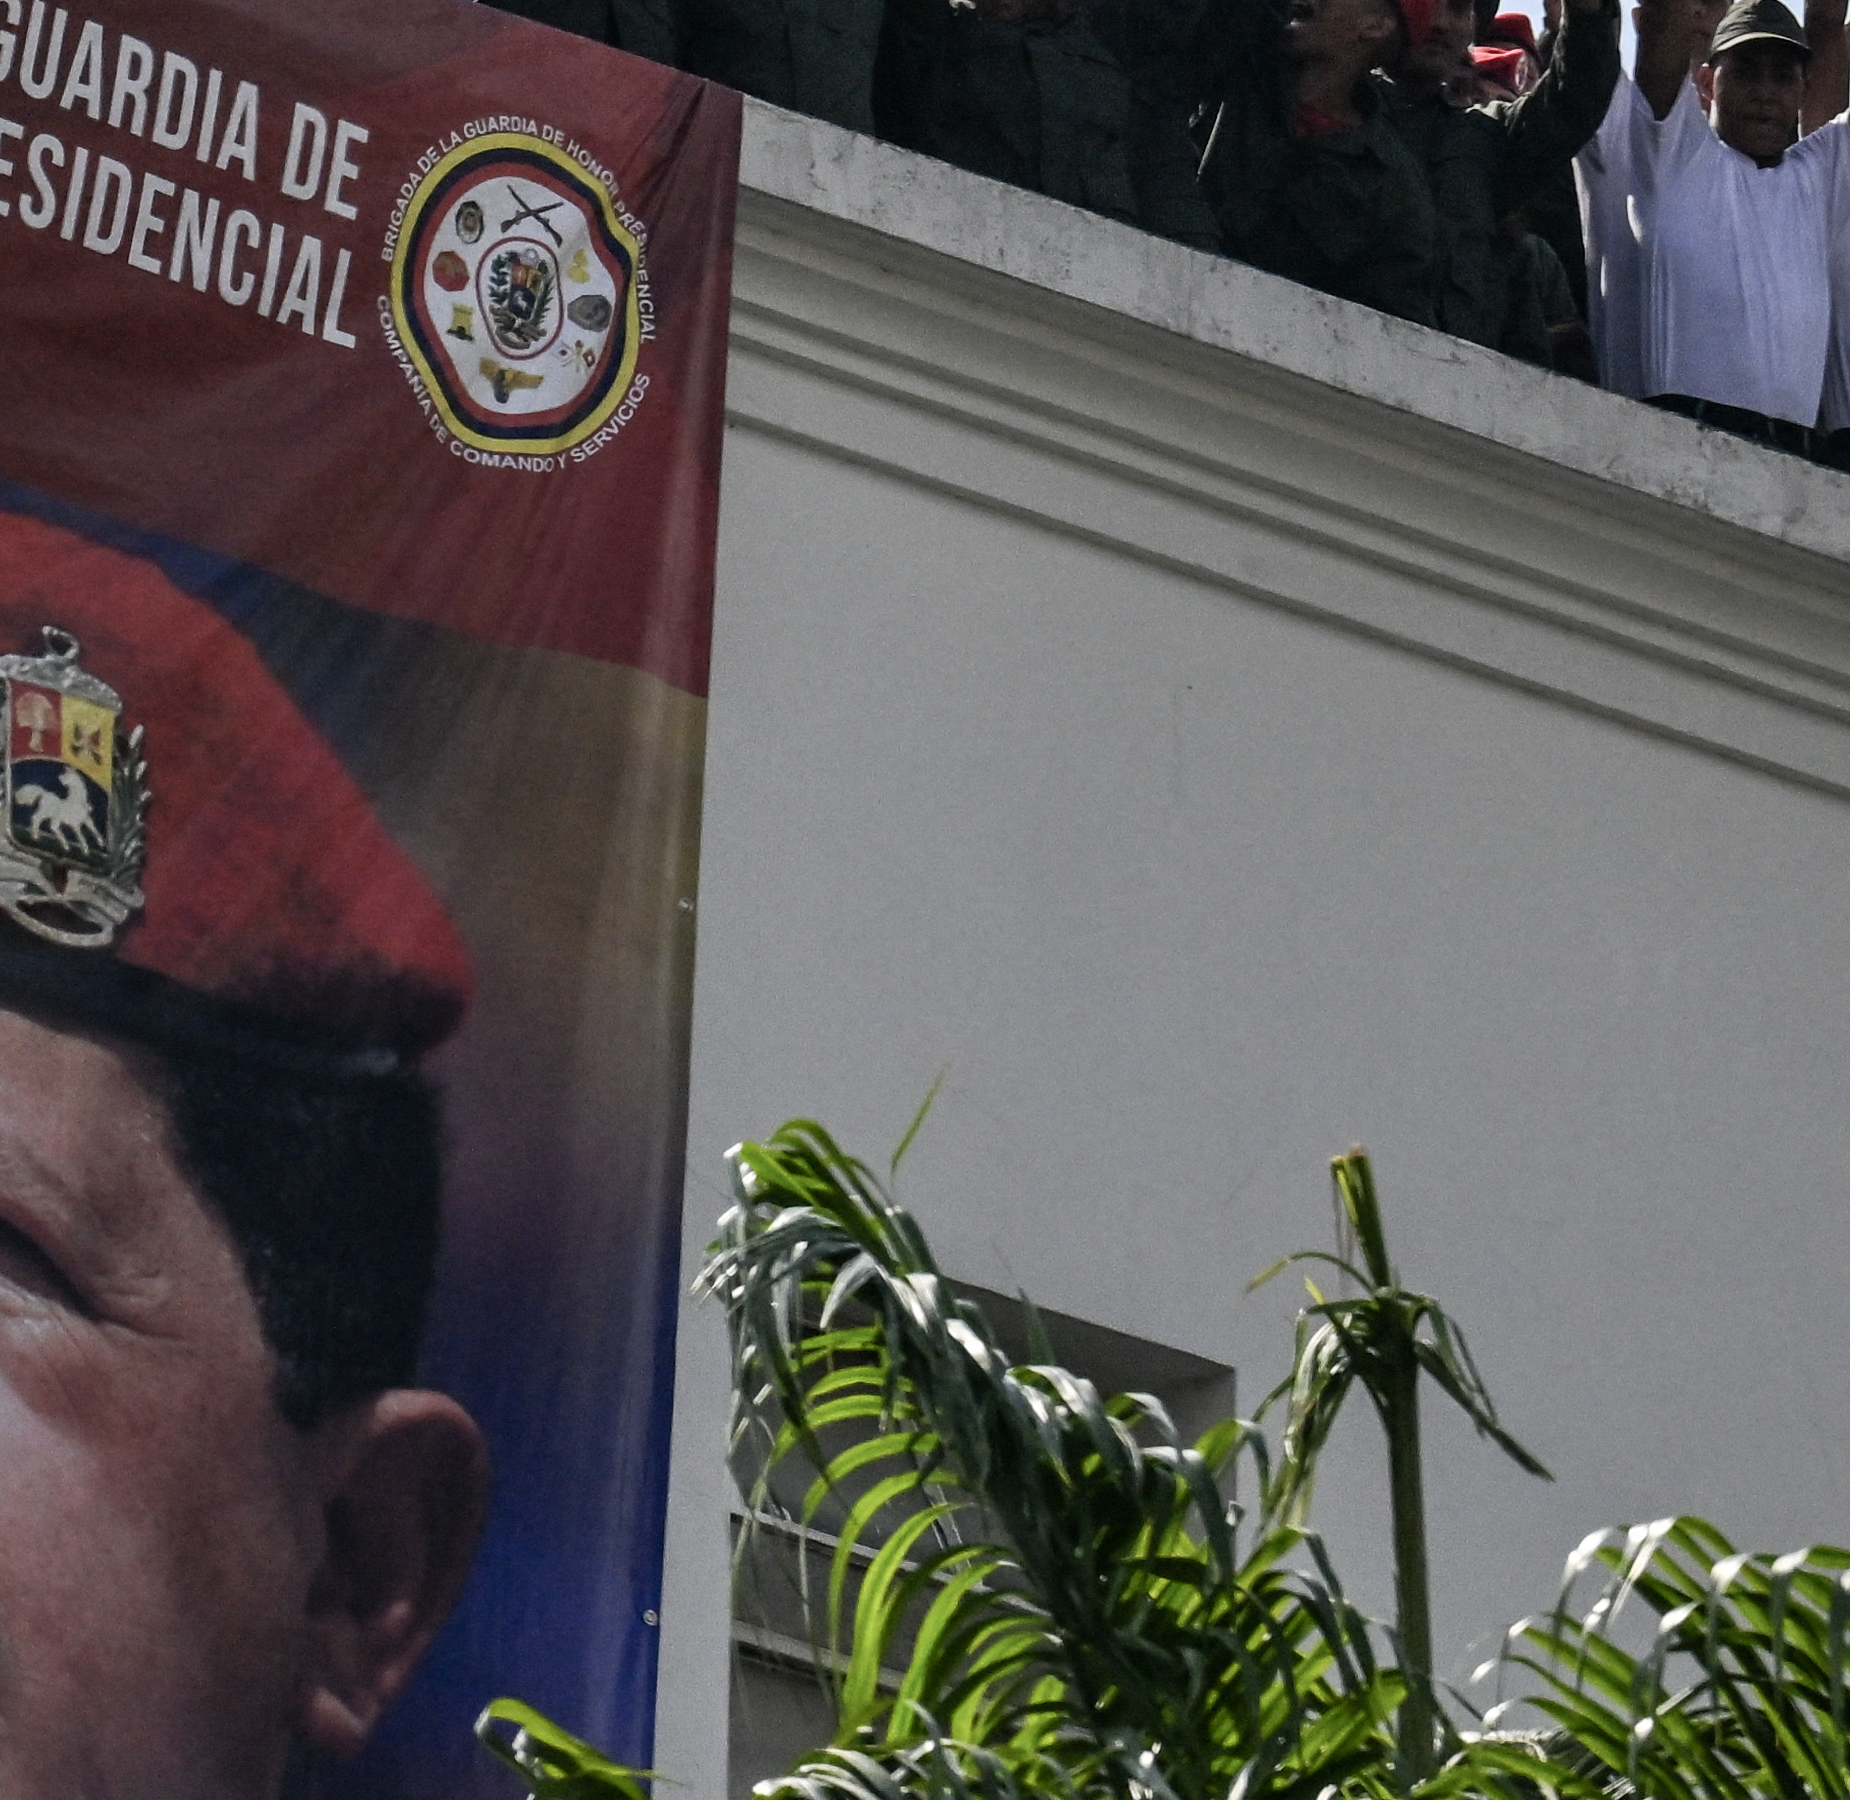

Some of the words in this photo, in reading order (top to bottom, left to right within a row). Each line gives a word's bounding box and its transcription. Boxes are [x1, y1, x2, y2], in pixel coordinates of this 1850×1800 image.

[281, 101, 369, 221] DE
[381, 172, 422, 262] BRIGADA
[417, 146, 441, 172] DE
[439, 130, 463, 152] LA
[463, 115, 538, 138] GUARDIA
[542, 124, 565, 146] DE
[567, 141, 619, 198] HONOR
[614, 200, 657, 345] PRESIDENCIAL
[376, 295, 430, 416] COMPAÑÍA
[429, 413, 449, 444] DE
[449, 440, 556, 473] COMANDO
[557, 455, 566, 469] Y
[569, 372, 651, 464] SERVICIOS
